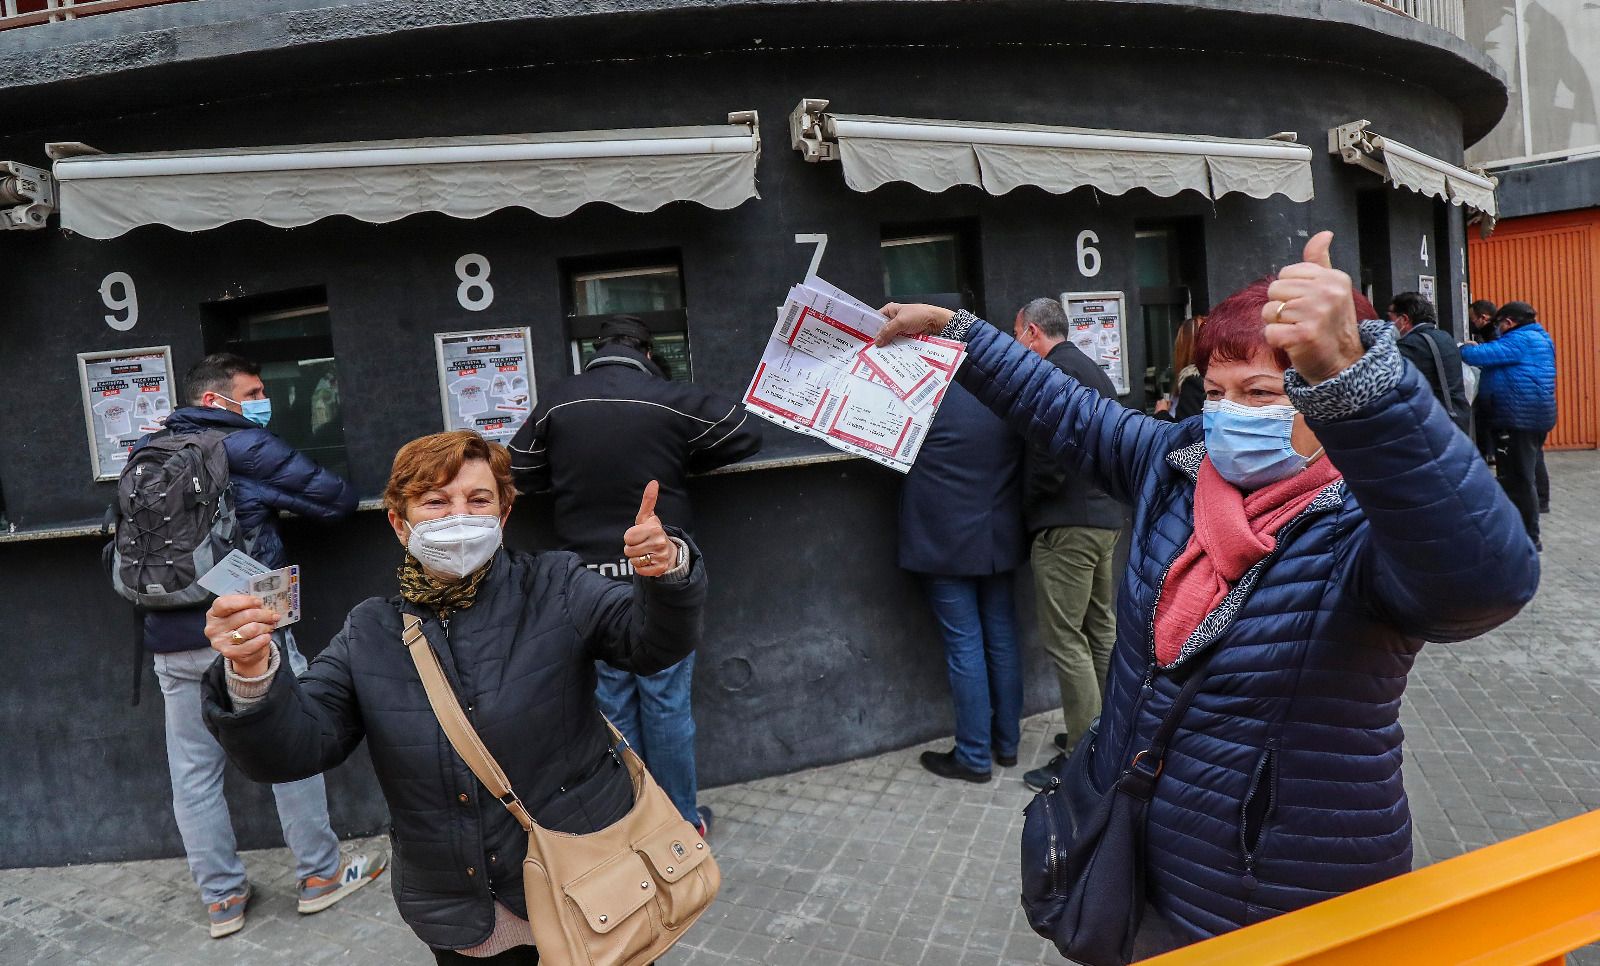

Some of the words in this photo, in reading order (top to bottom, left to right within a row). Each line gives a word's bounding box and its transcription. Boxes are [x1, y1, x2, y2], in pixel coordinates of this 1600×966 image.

[795, 233, 828, 286] 7
[1077, 230, 1101, 277] 6
[1420, 234, 1429, 267] 4
[98, 271, 139, 331] 9
[455, 253, 494, 311] 8
[346, 865, 358, 882] N
